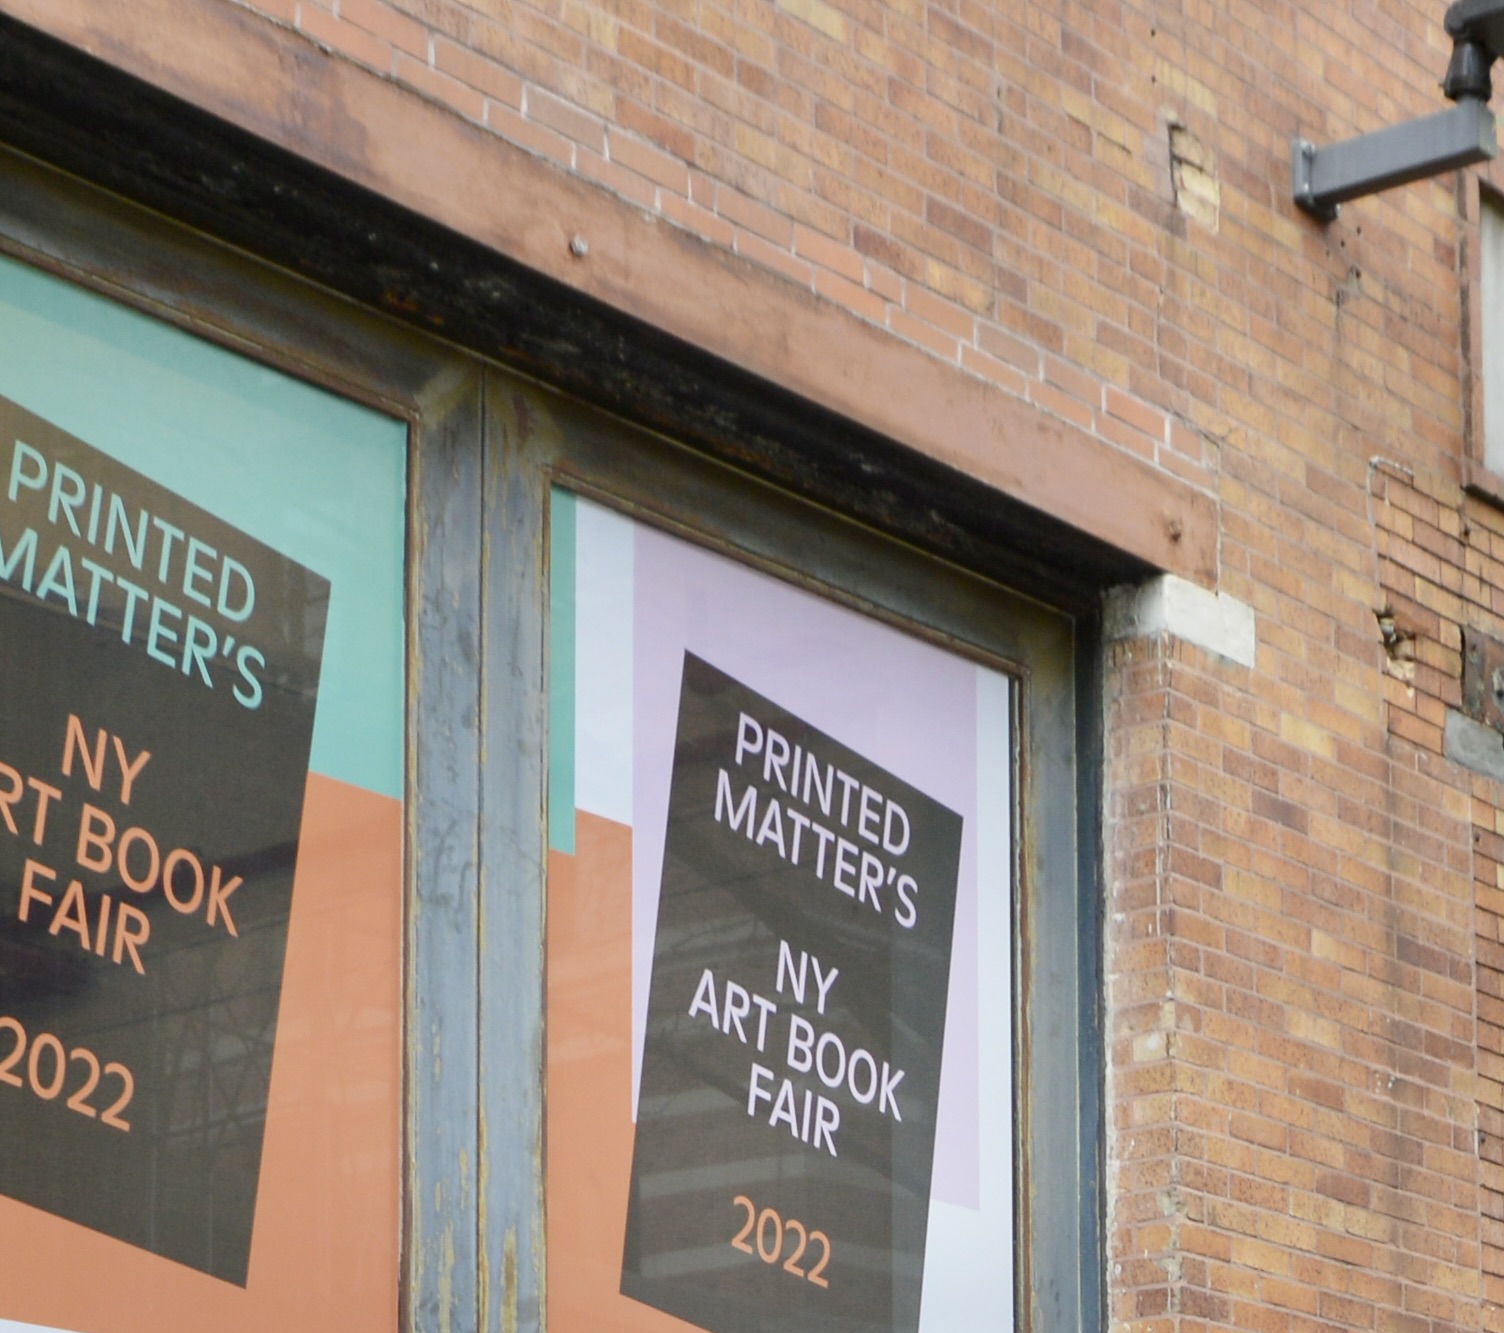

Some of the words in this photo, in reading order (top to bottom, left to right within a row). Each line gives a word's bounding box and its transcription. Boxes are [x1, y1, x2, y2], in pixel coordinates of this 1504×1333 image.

[8, 439, 256, 623] PRINTED
[61, 713, 152, 806] NY
[735, 711, 911, 856] PRINTED
[76, 802, 243, 938] BOOK
[714, 767, 918, 928] MATTER'S
[19, 858, 151, 976] FAIR
[776, 939, 839, 1015] NY
[688, 968, 777, 1053] ART
[787, 1013, 905, 1122] BOOK
[747, 1062, 840, 1158] FAIR
[731, 1195, 831, 1289] 2022
